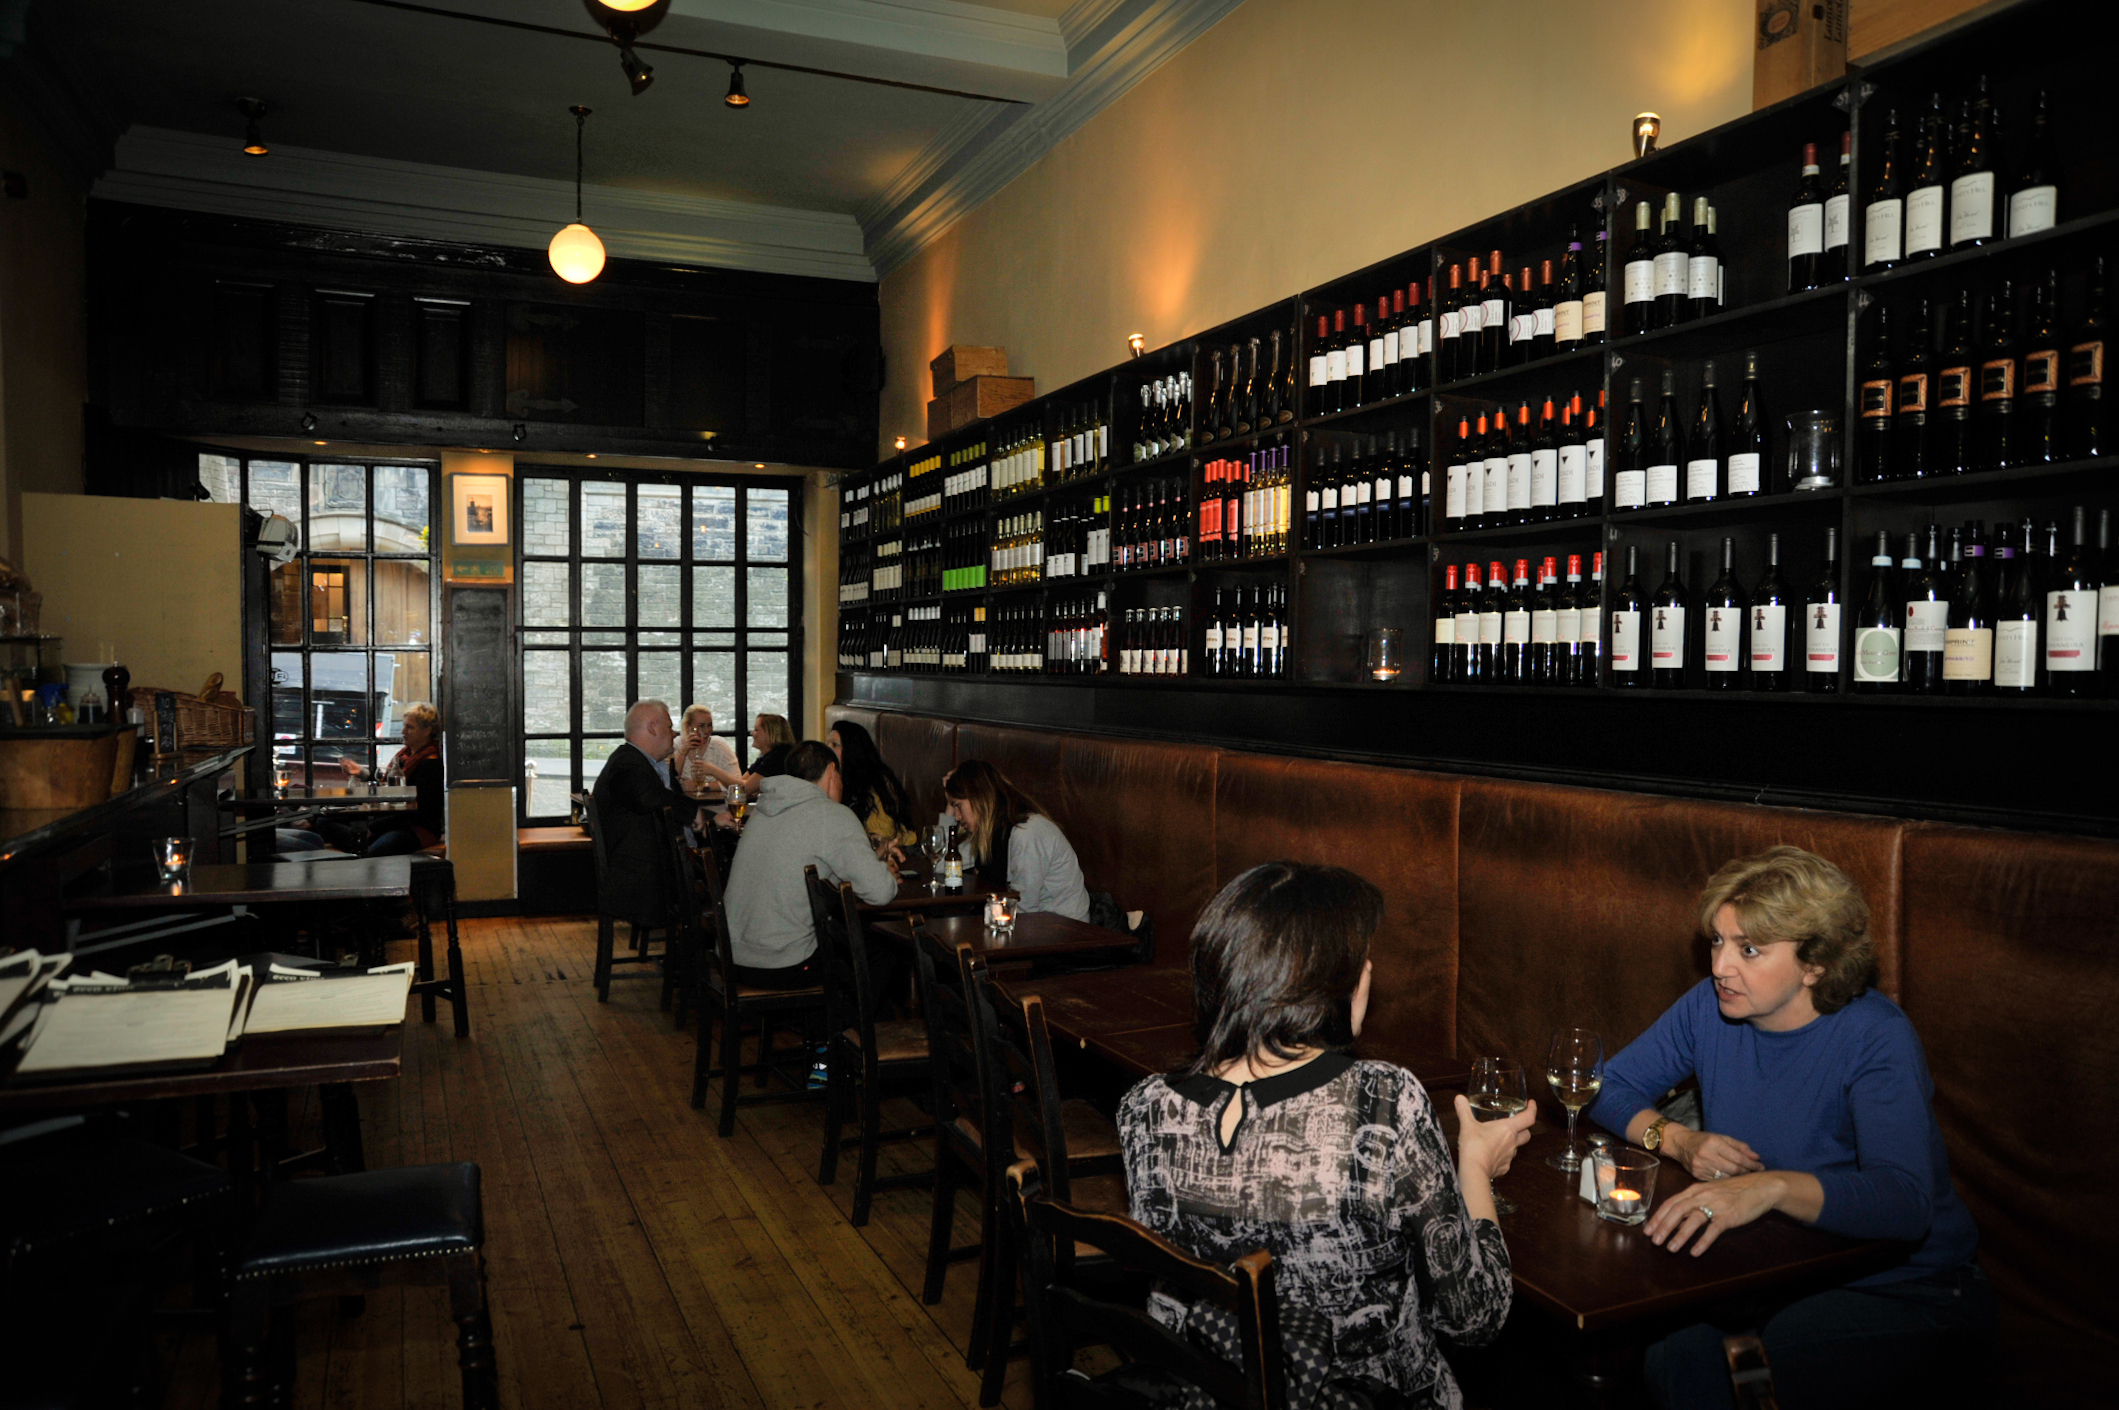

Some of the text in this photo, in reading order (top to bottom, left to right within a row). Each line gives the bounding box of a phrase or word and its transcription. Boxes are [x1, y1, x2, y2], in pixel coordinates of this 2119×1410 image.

[1861, 83, 1873, 98] 42
[1836, 92, 1849, 106] 39
[1593, 197, 1603, 208] 35
[1616, 188, 1626, 205] 38
[1611, 357, 1623, 368] 40
